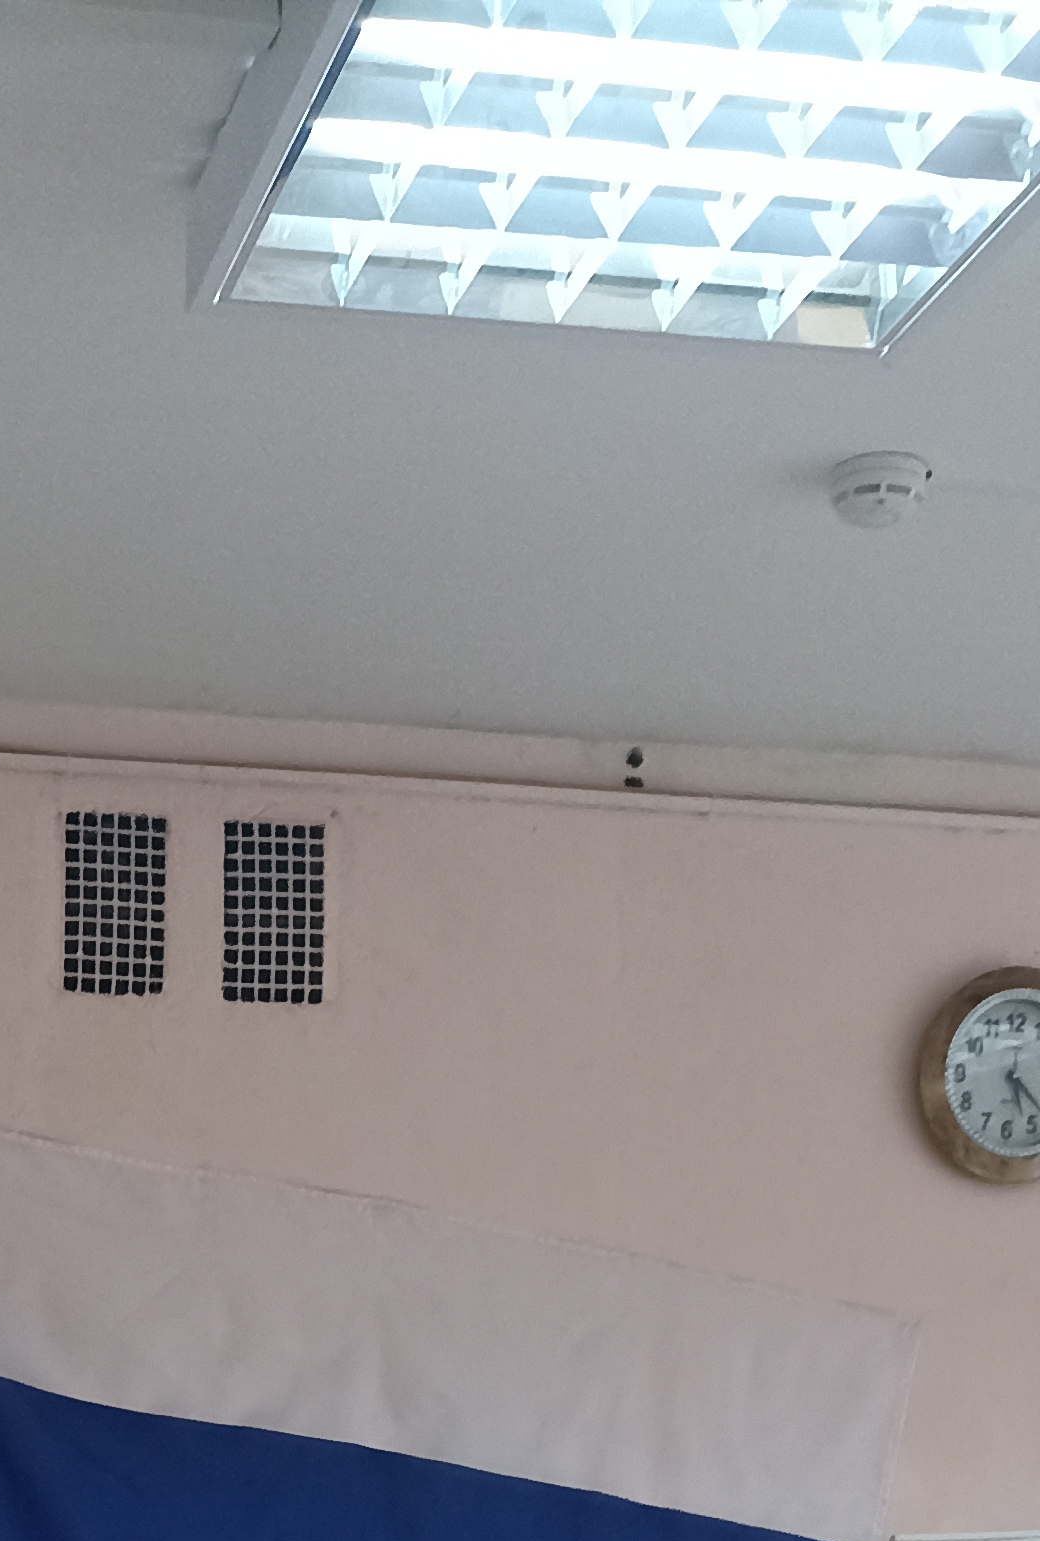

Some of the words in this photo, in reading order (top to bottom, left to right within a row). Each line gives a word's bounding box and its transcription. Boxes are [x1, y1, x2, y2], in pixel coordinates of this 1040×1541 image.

[984, 1018, 1000, 1038] 11
[1006, 1012, 1027, 1033] 12
[961, 1090, 972, 1112] 8
[981, 1111, 993, 1131] 7
[1000, 1119, 1013, 1140] 6
[1025, 1114, 1039, 1135] 5
